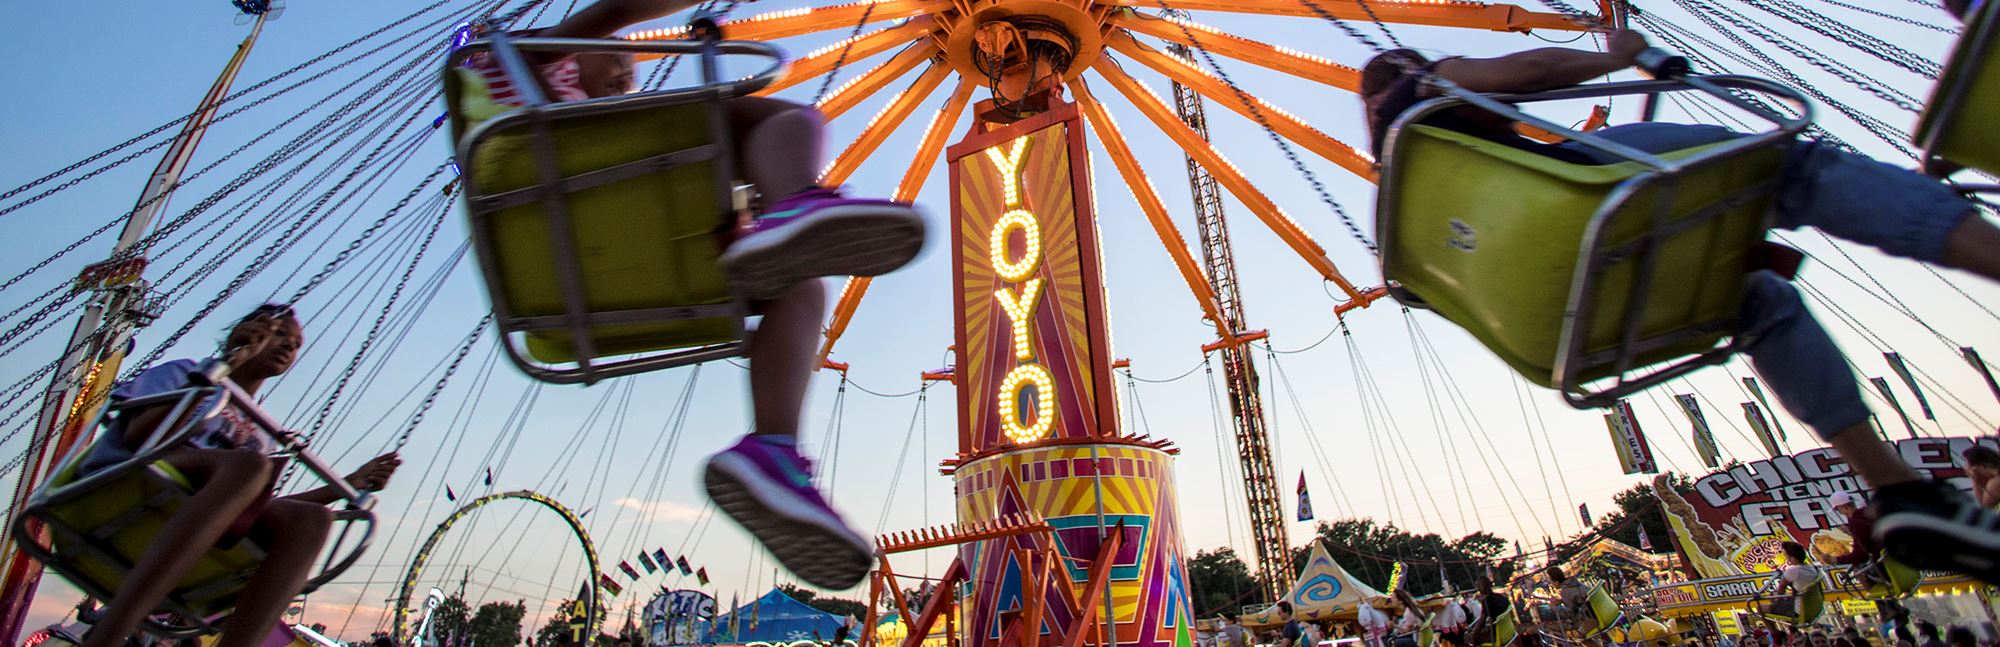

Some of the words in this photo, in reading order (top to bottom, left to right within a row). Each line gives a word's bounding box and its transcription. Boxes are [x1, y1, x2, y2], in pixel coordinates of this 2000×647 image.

[986, 135, 1058, 444] YOYO
[1616, 403, 1642, 460] FRIES
[1695, 436, 2000, 508] CHICEN
[1705, 580, 1759, 598] SPIRAL
